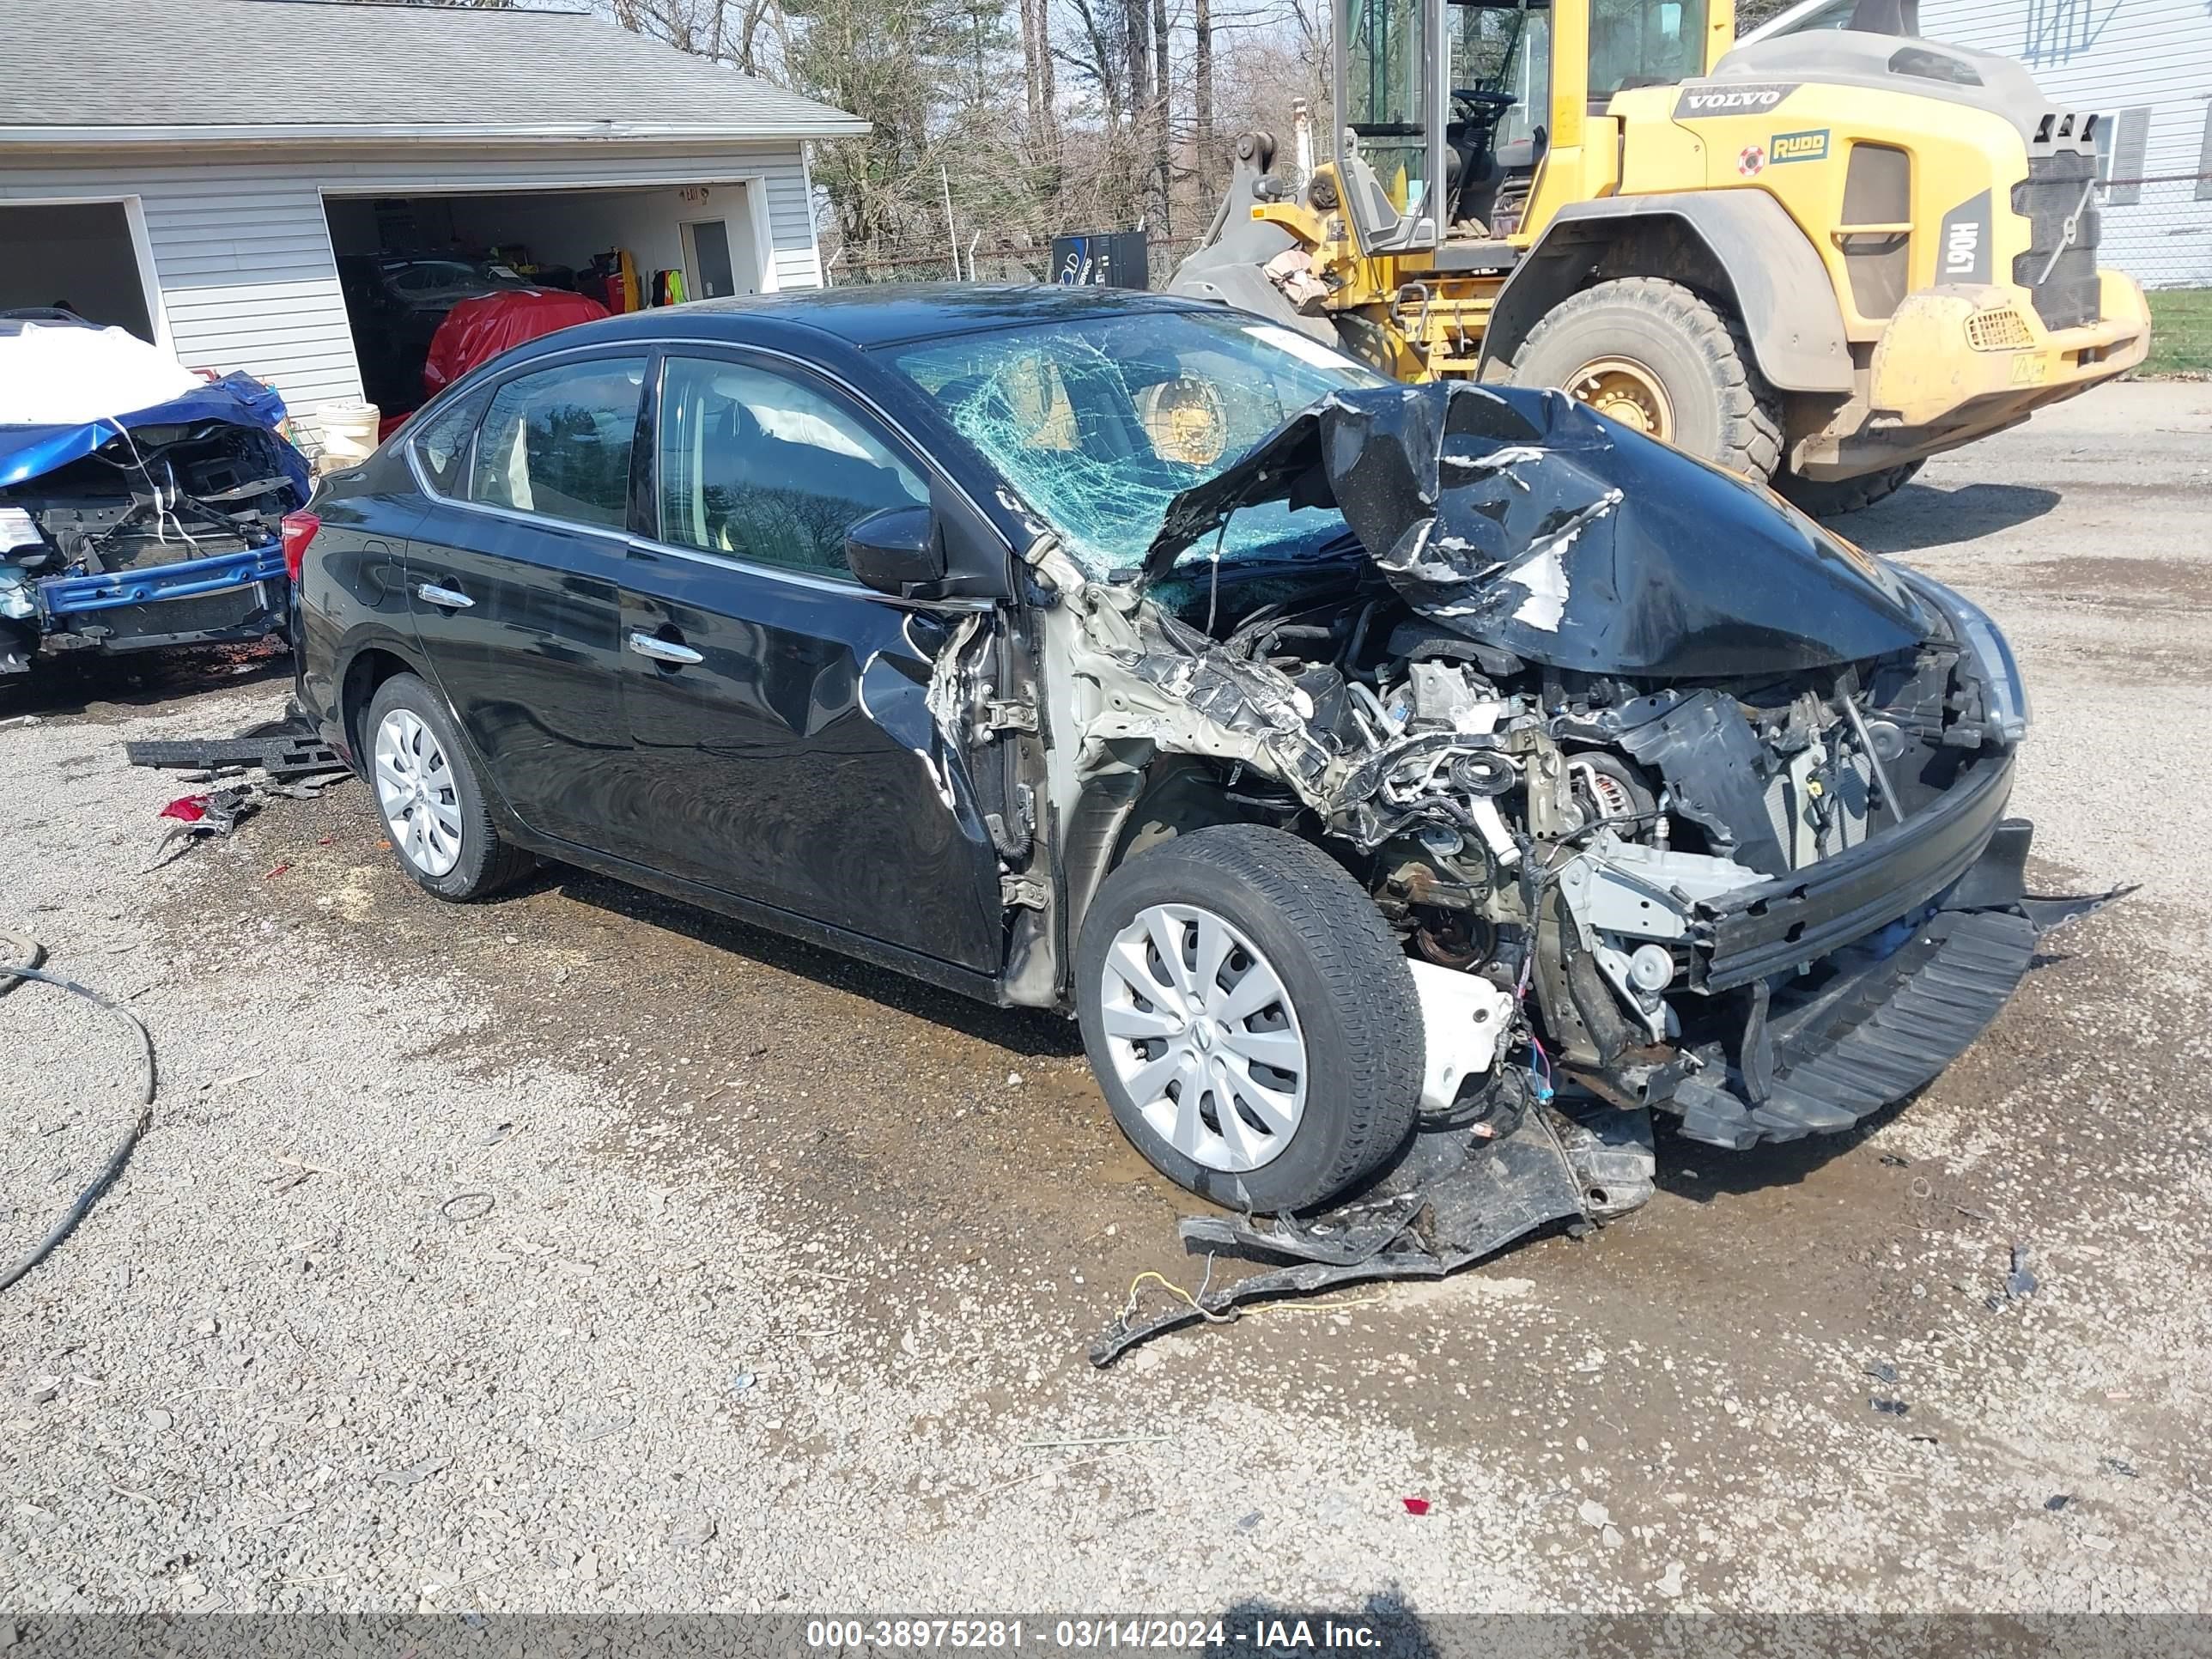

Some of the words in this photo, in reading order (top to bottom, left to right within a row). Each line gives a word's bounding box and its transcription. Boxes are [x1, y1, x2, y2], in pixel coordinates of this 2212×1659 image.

[1687, 91, 1781, 109] VOLVO
[1773, 134, 1826, 160] RUDD
[1946, 222, 1979, 274] L90H
[1059, 252, 1079, 285] OLD
[1078, 257, 1093, 286] RINKS
